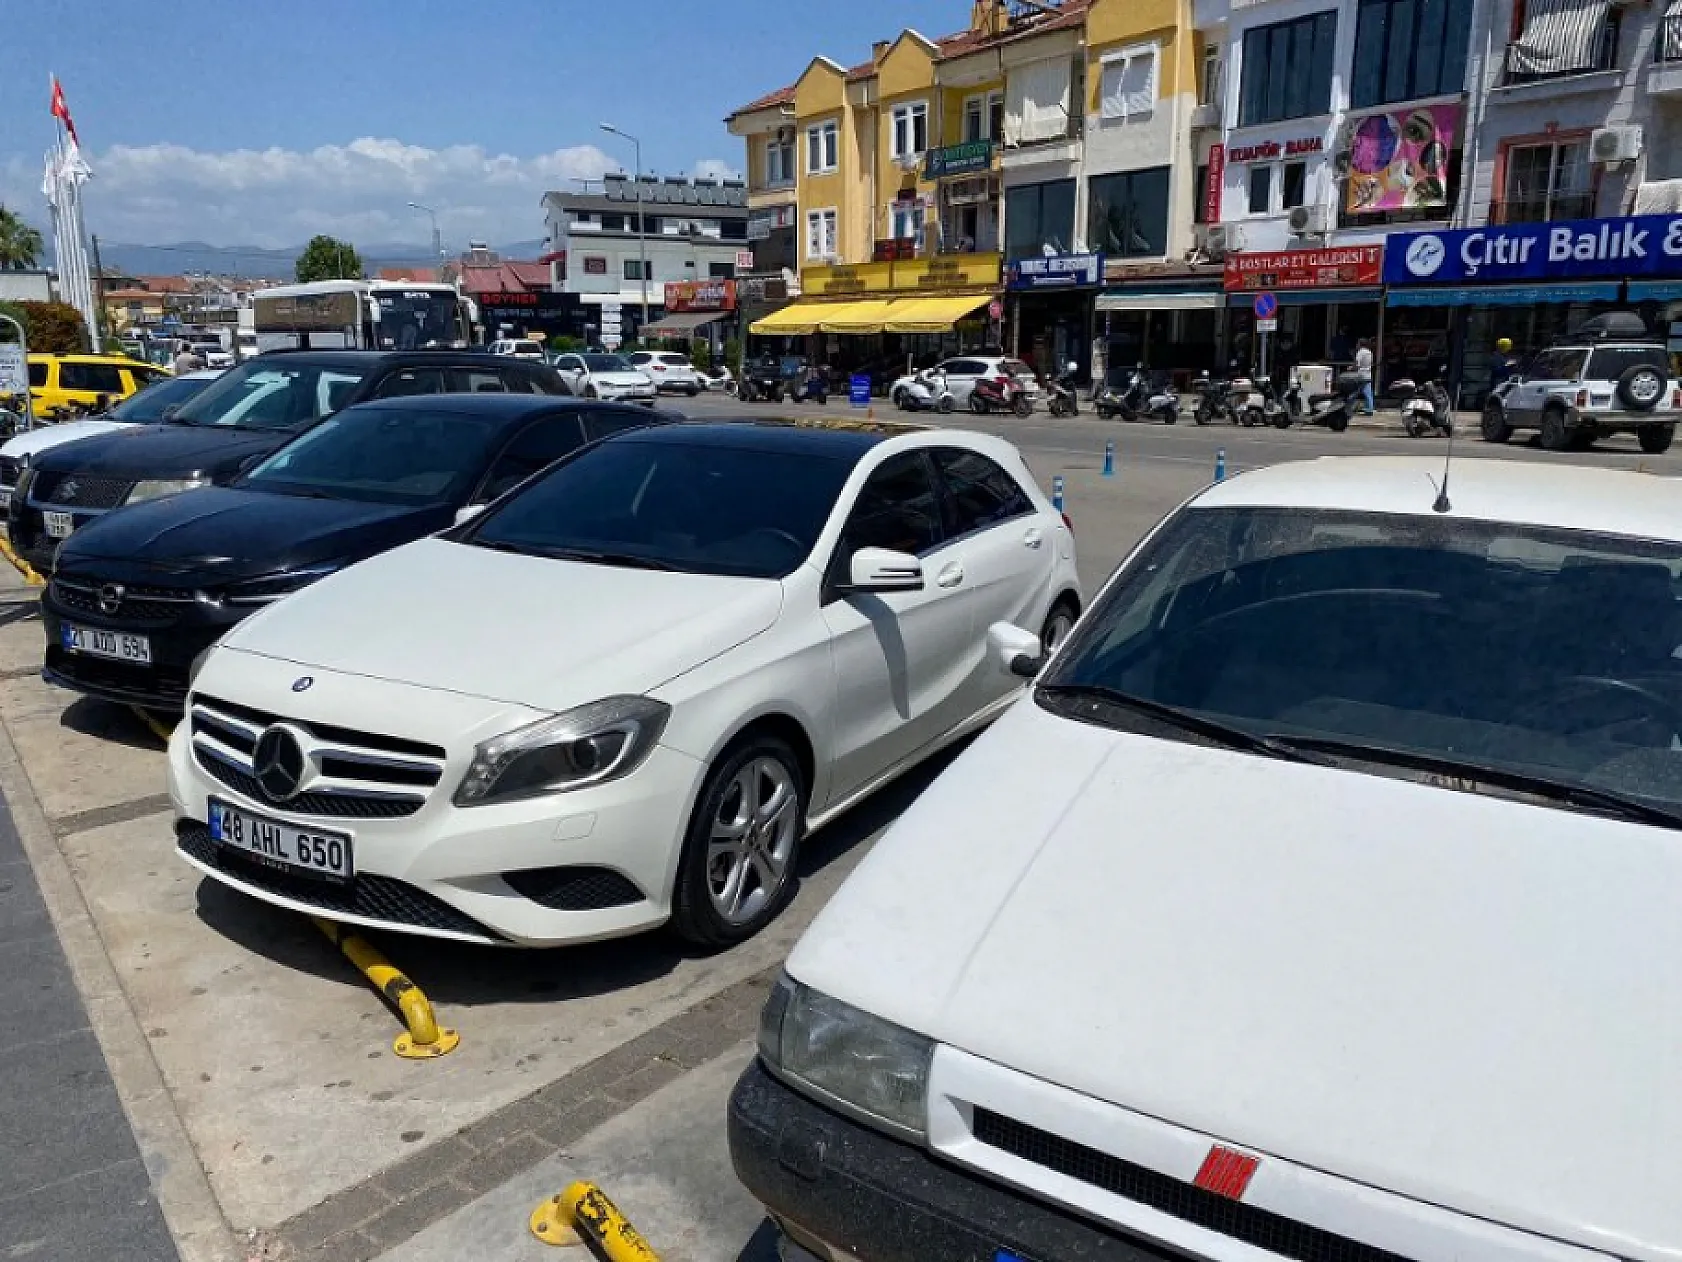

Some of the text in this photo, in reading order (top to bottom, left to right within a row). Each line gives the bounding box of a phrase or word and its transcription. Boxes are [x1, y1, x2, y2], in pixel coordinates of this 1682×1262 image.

[1461, 232, 1537, 276] Çıtır
[1549, 222, 1649, 262] Balık
[222, 810, 243, 842] 48
[251, 820, 290, 859] AHL
[298, 834, 342, 871] 650
